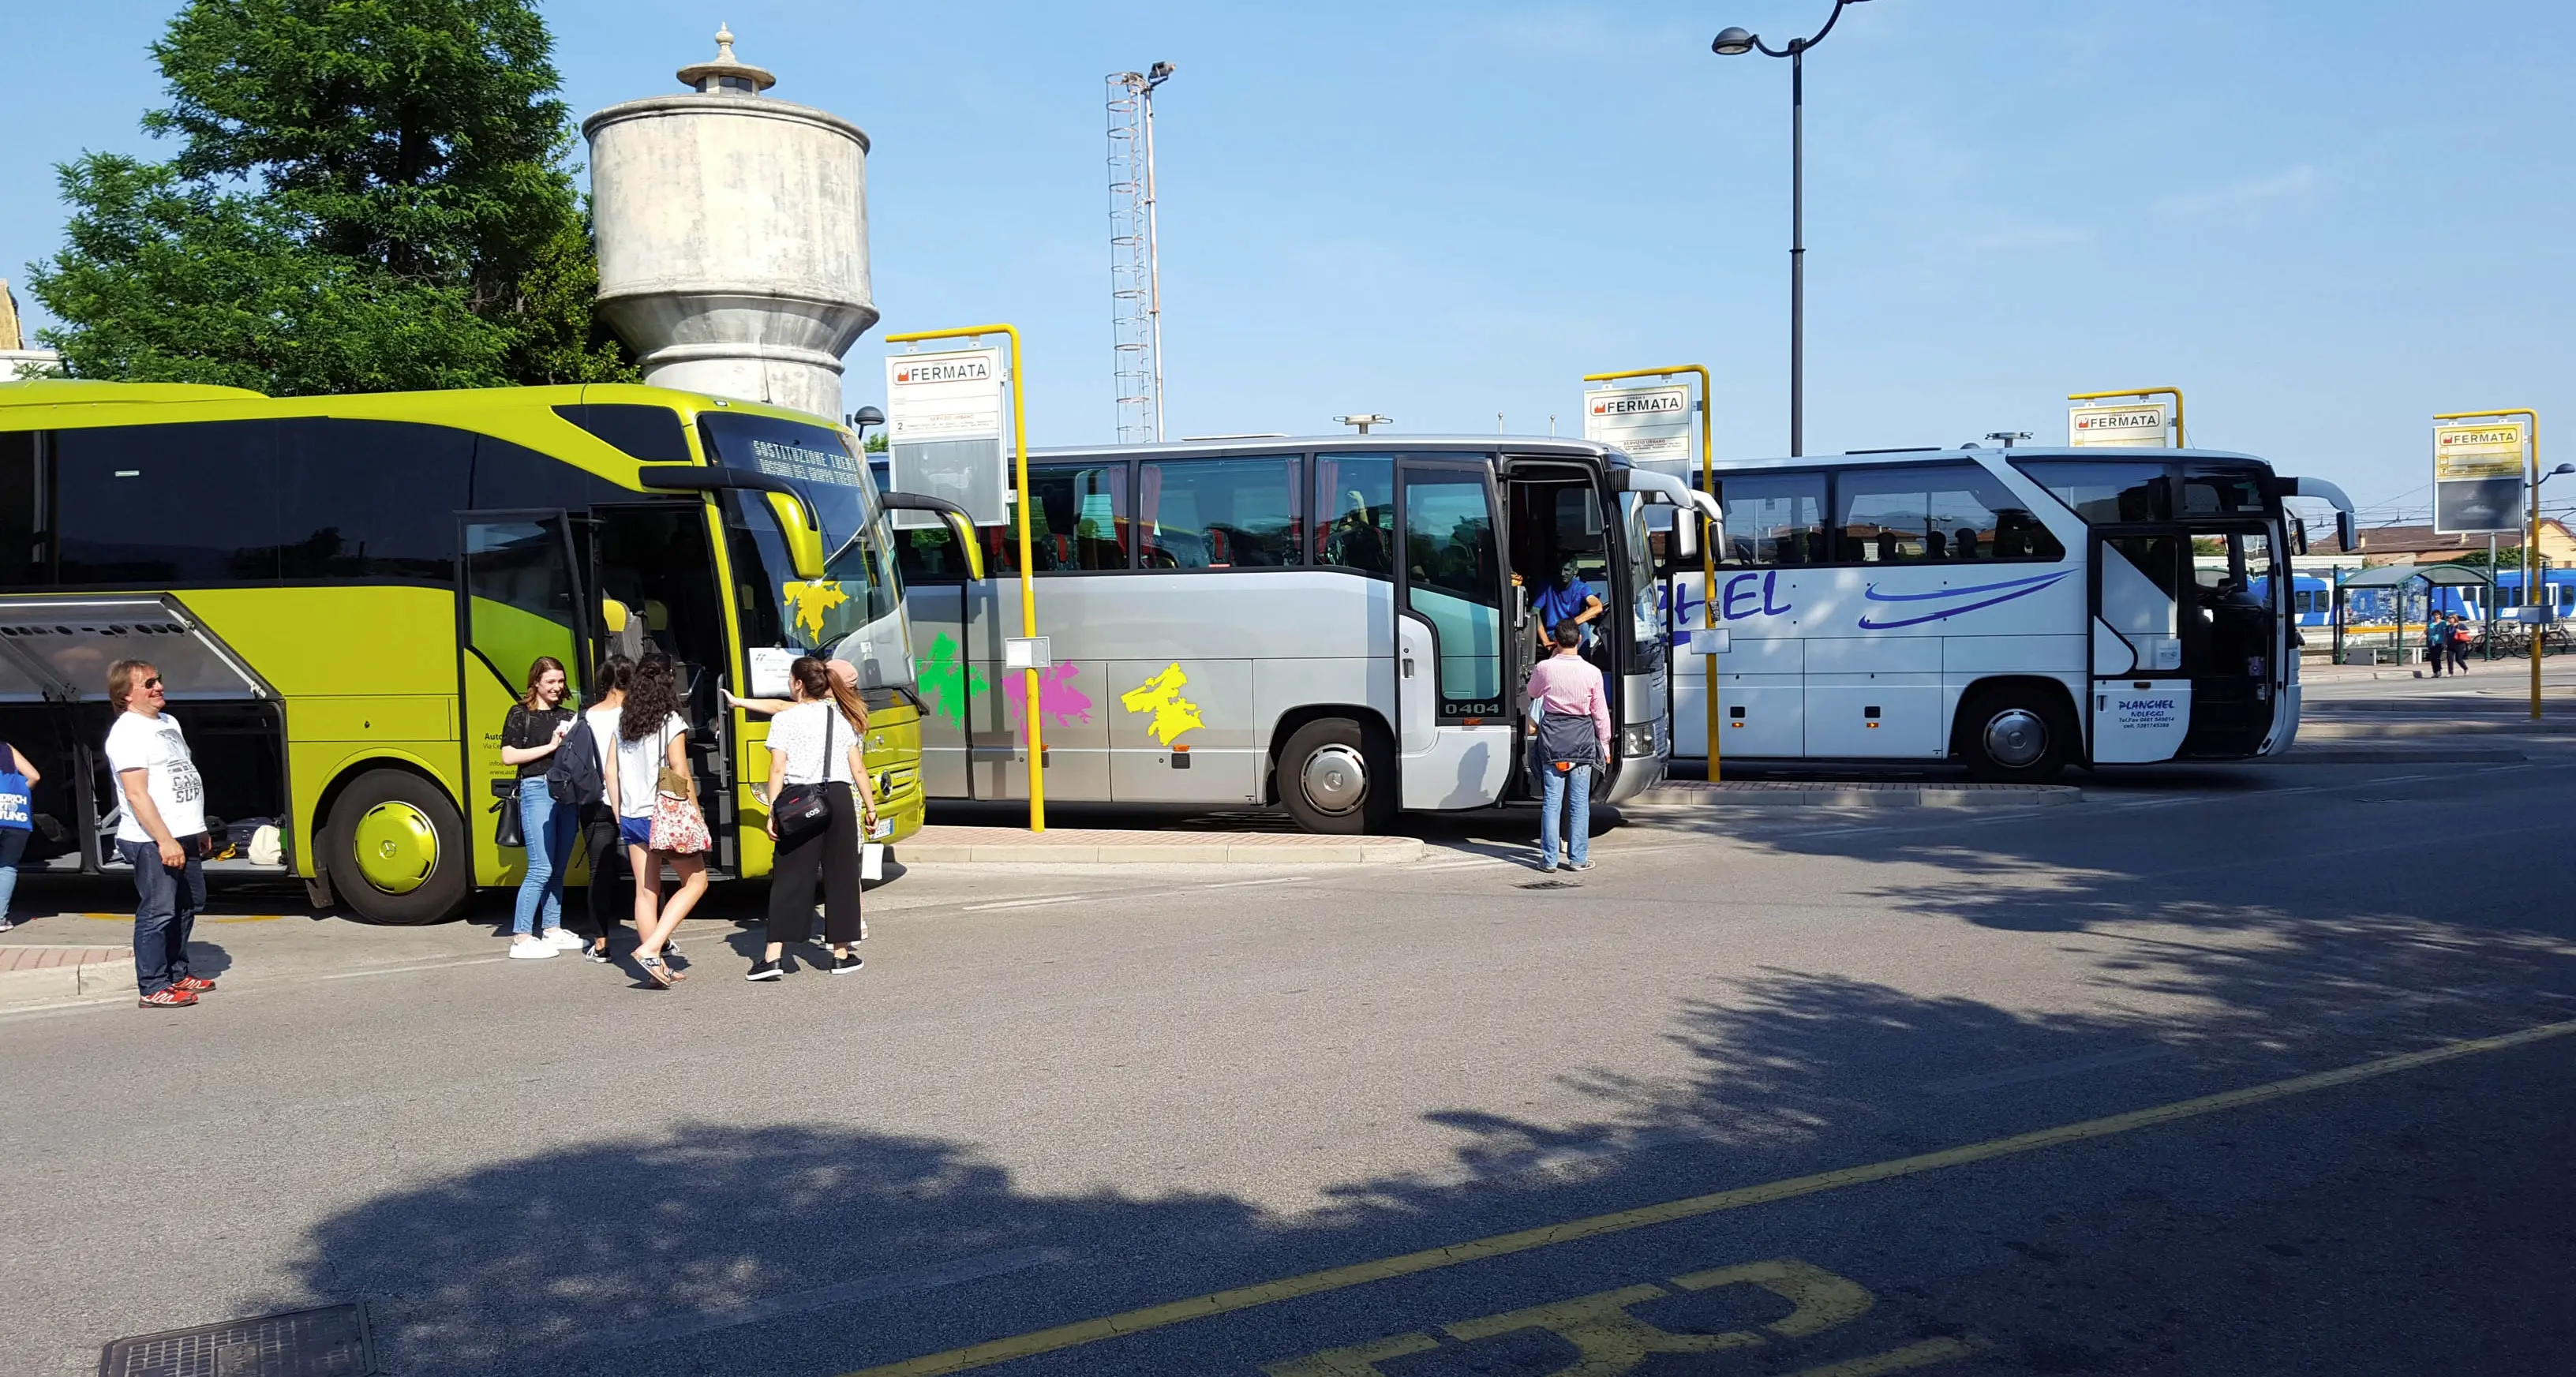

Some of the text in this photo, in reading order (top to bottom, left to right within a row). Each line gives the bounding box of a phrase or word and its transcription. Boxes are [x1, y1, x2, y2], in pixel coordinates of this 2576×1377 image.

[911, 363, 987, 381] FERMATA
[1608, 398, 1679, 413] FERMATA
[2091, 415, 2156, 428] FERMATA
[2454, 432, 2514, 443] FERMATA
[752, 440, 828, 466] SOSTITUZIONE
[1445, 703, 1500, 714] 0404
[2118, 700, 2175, 710] PLANCHEL
[805, 807, 821, 818] EOS
